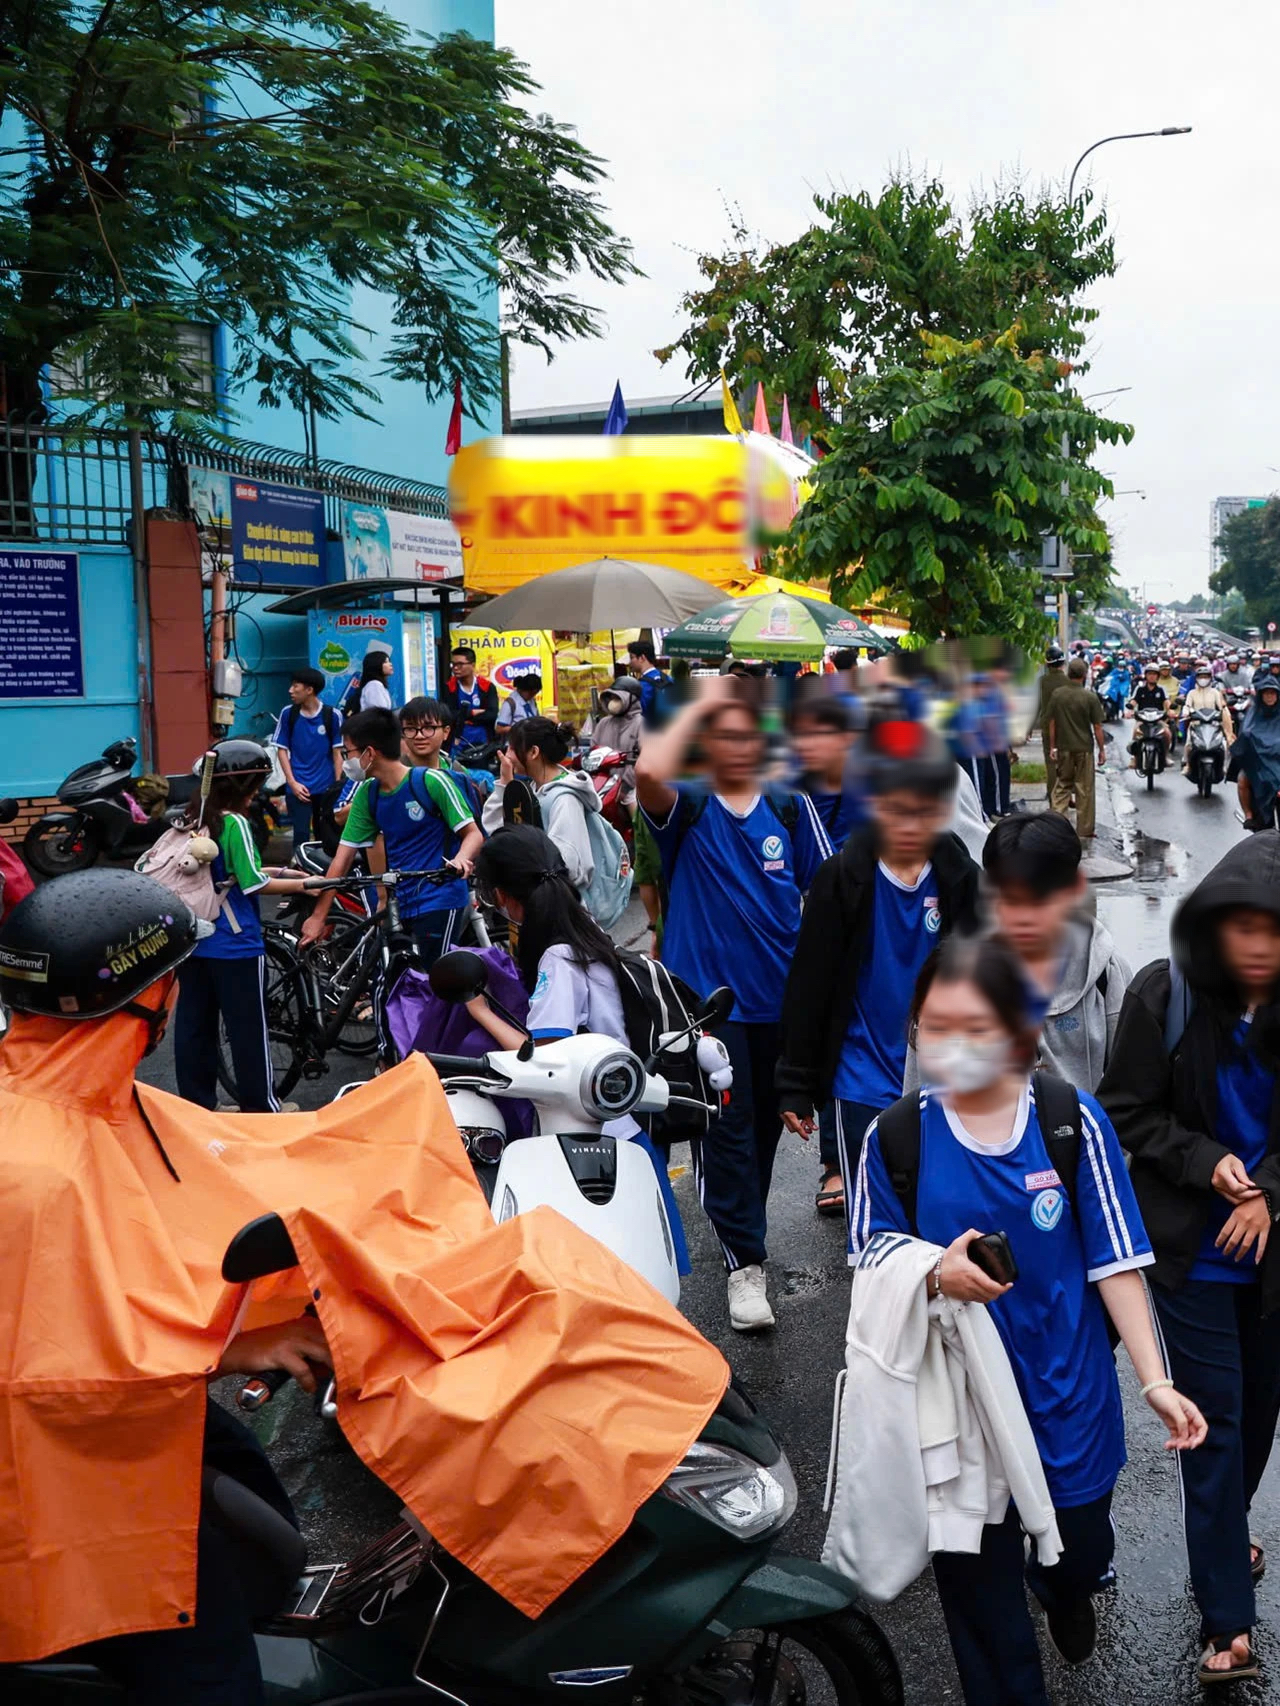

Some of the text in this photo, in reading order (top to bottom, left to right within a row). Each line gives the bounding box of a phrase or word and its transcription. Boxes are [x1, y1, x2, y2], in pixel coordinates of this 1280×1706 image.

[13, 556, 31, 568] VÀO
[33, 557, 66, 570] TRƯỜNG
[338, 614, 388, 627] Bidrico
[459, 632, 505, 648] PHẨM
[138, 929, 169, 959] RỤNG
[0, 951, 44, 970] TRESemmé
